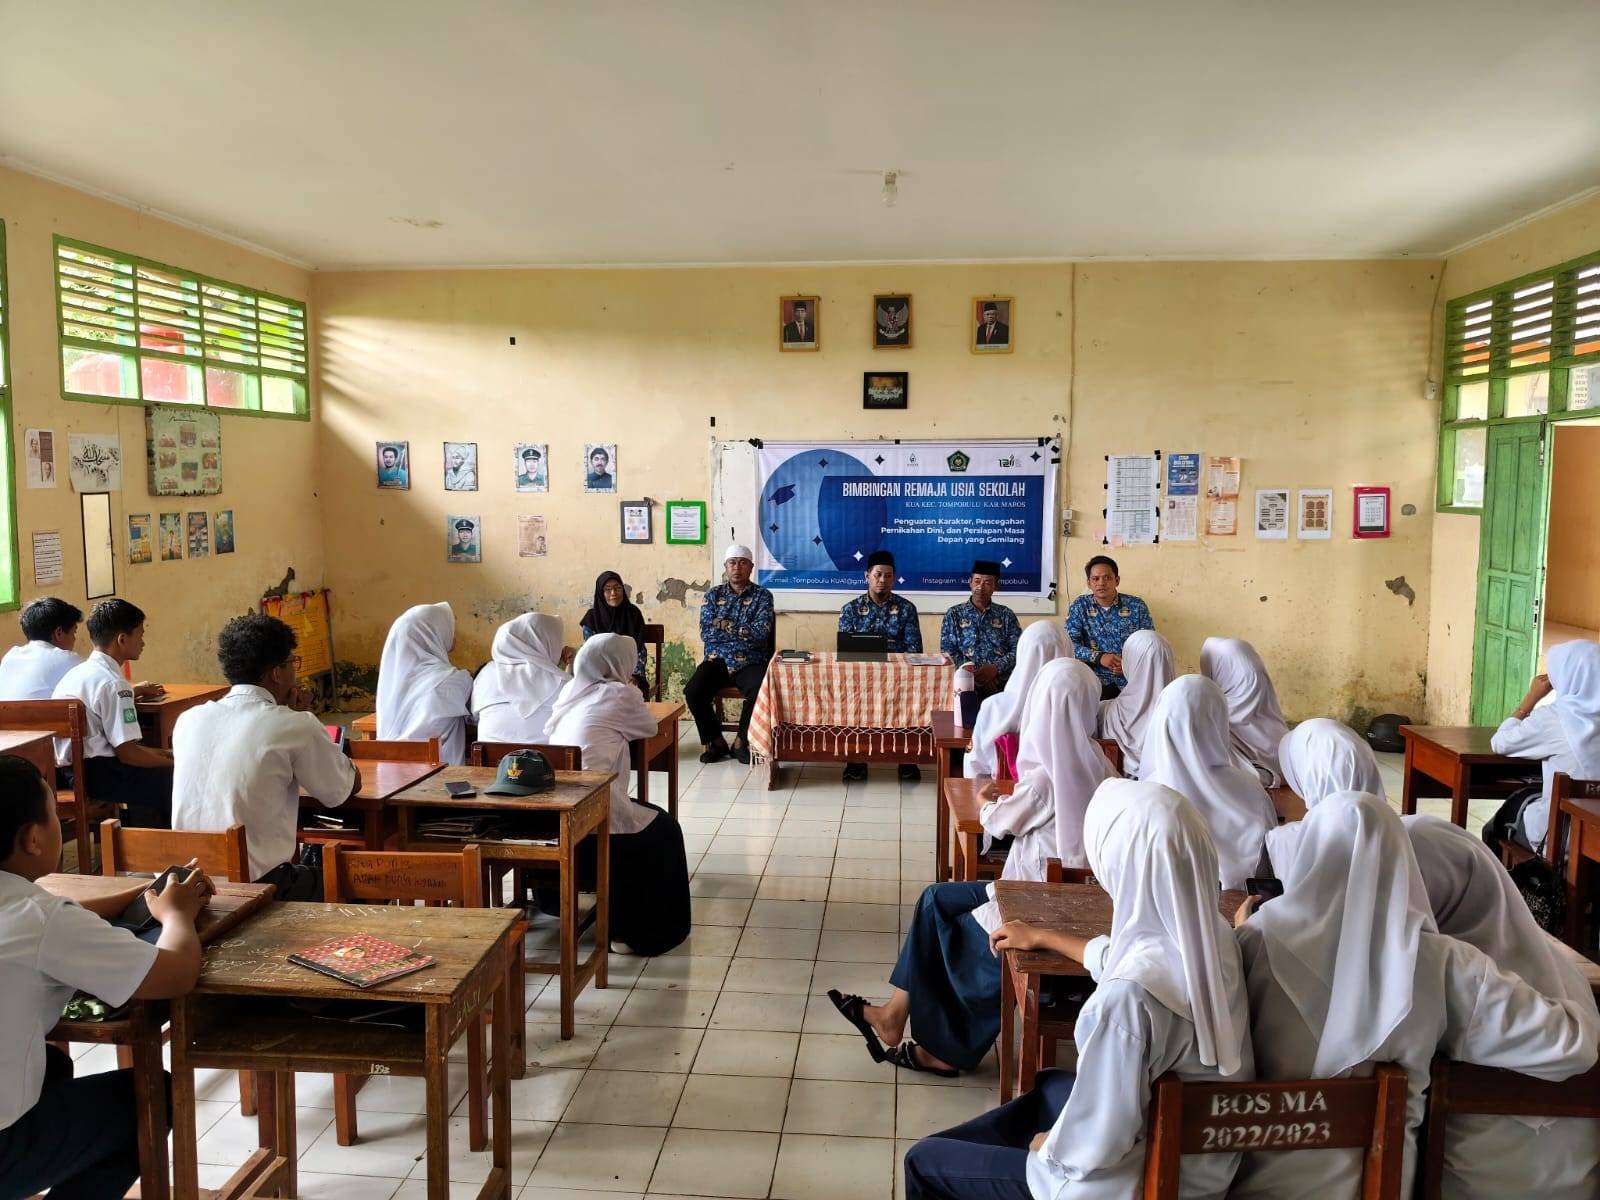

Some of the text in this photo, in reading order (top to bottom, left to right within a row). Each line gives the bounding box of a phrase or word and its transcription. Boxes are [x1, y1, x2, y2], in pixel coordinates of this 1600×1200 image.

[842, 482, 1025, 497] BIMBINGAN REMAJA USIA SEKOLAH
[894, 518, 1025, 527] Penguatan Karakter, Pencegahan
[927, 527, 944, 535] Dini,
[963, 527, 1002, 536] Persiapan
[937, 536, 1025, 545] Depan yang Gemilang
[922, 577, 956, 585] Instagram
[1210, 1090, 1329, 1117] BOS MA
[1202, 1121, 1331, 1149] 2022/2023
